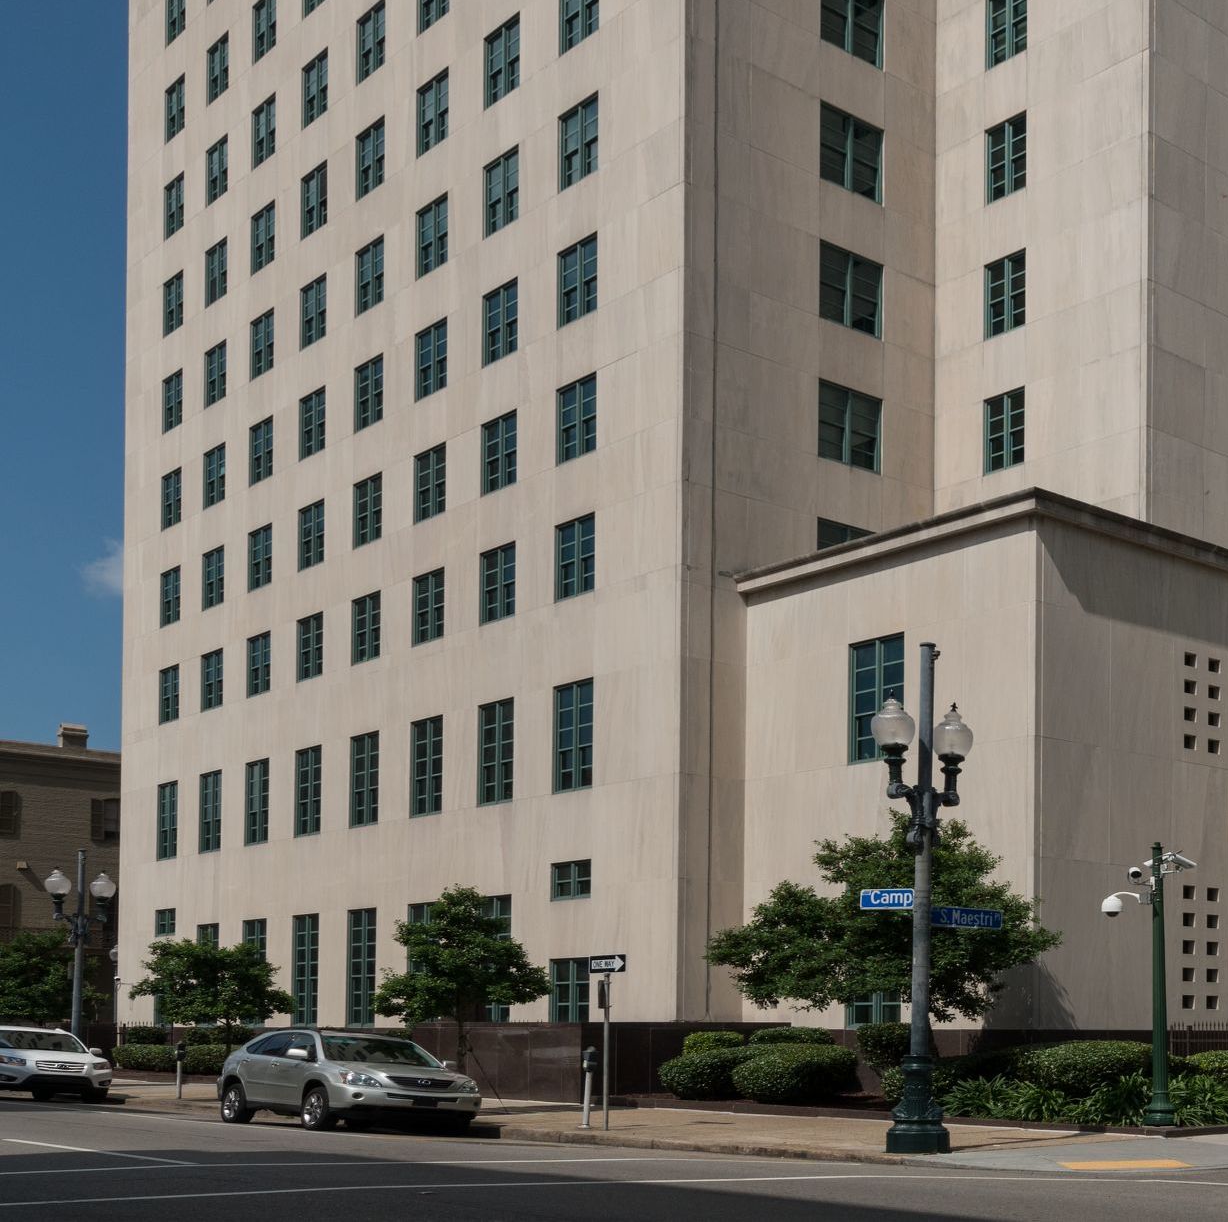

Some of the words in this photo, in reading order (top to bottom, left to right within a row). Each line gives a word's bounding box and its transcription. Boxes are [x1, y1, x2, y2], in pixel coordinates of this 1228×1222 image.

[871, 891, 912, 906] Camp
[940, 908, 950, 924] S.
[952, 909, 993, 927] Maestri
